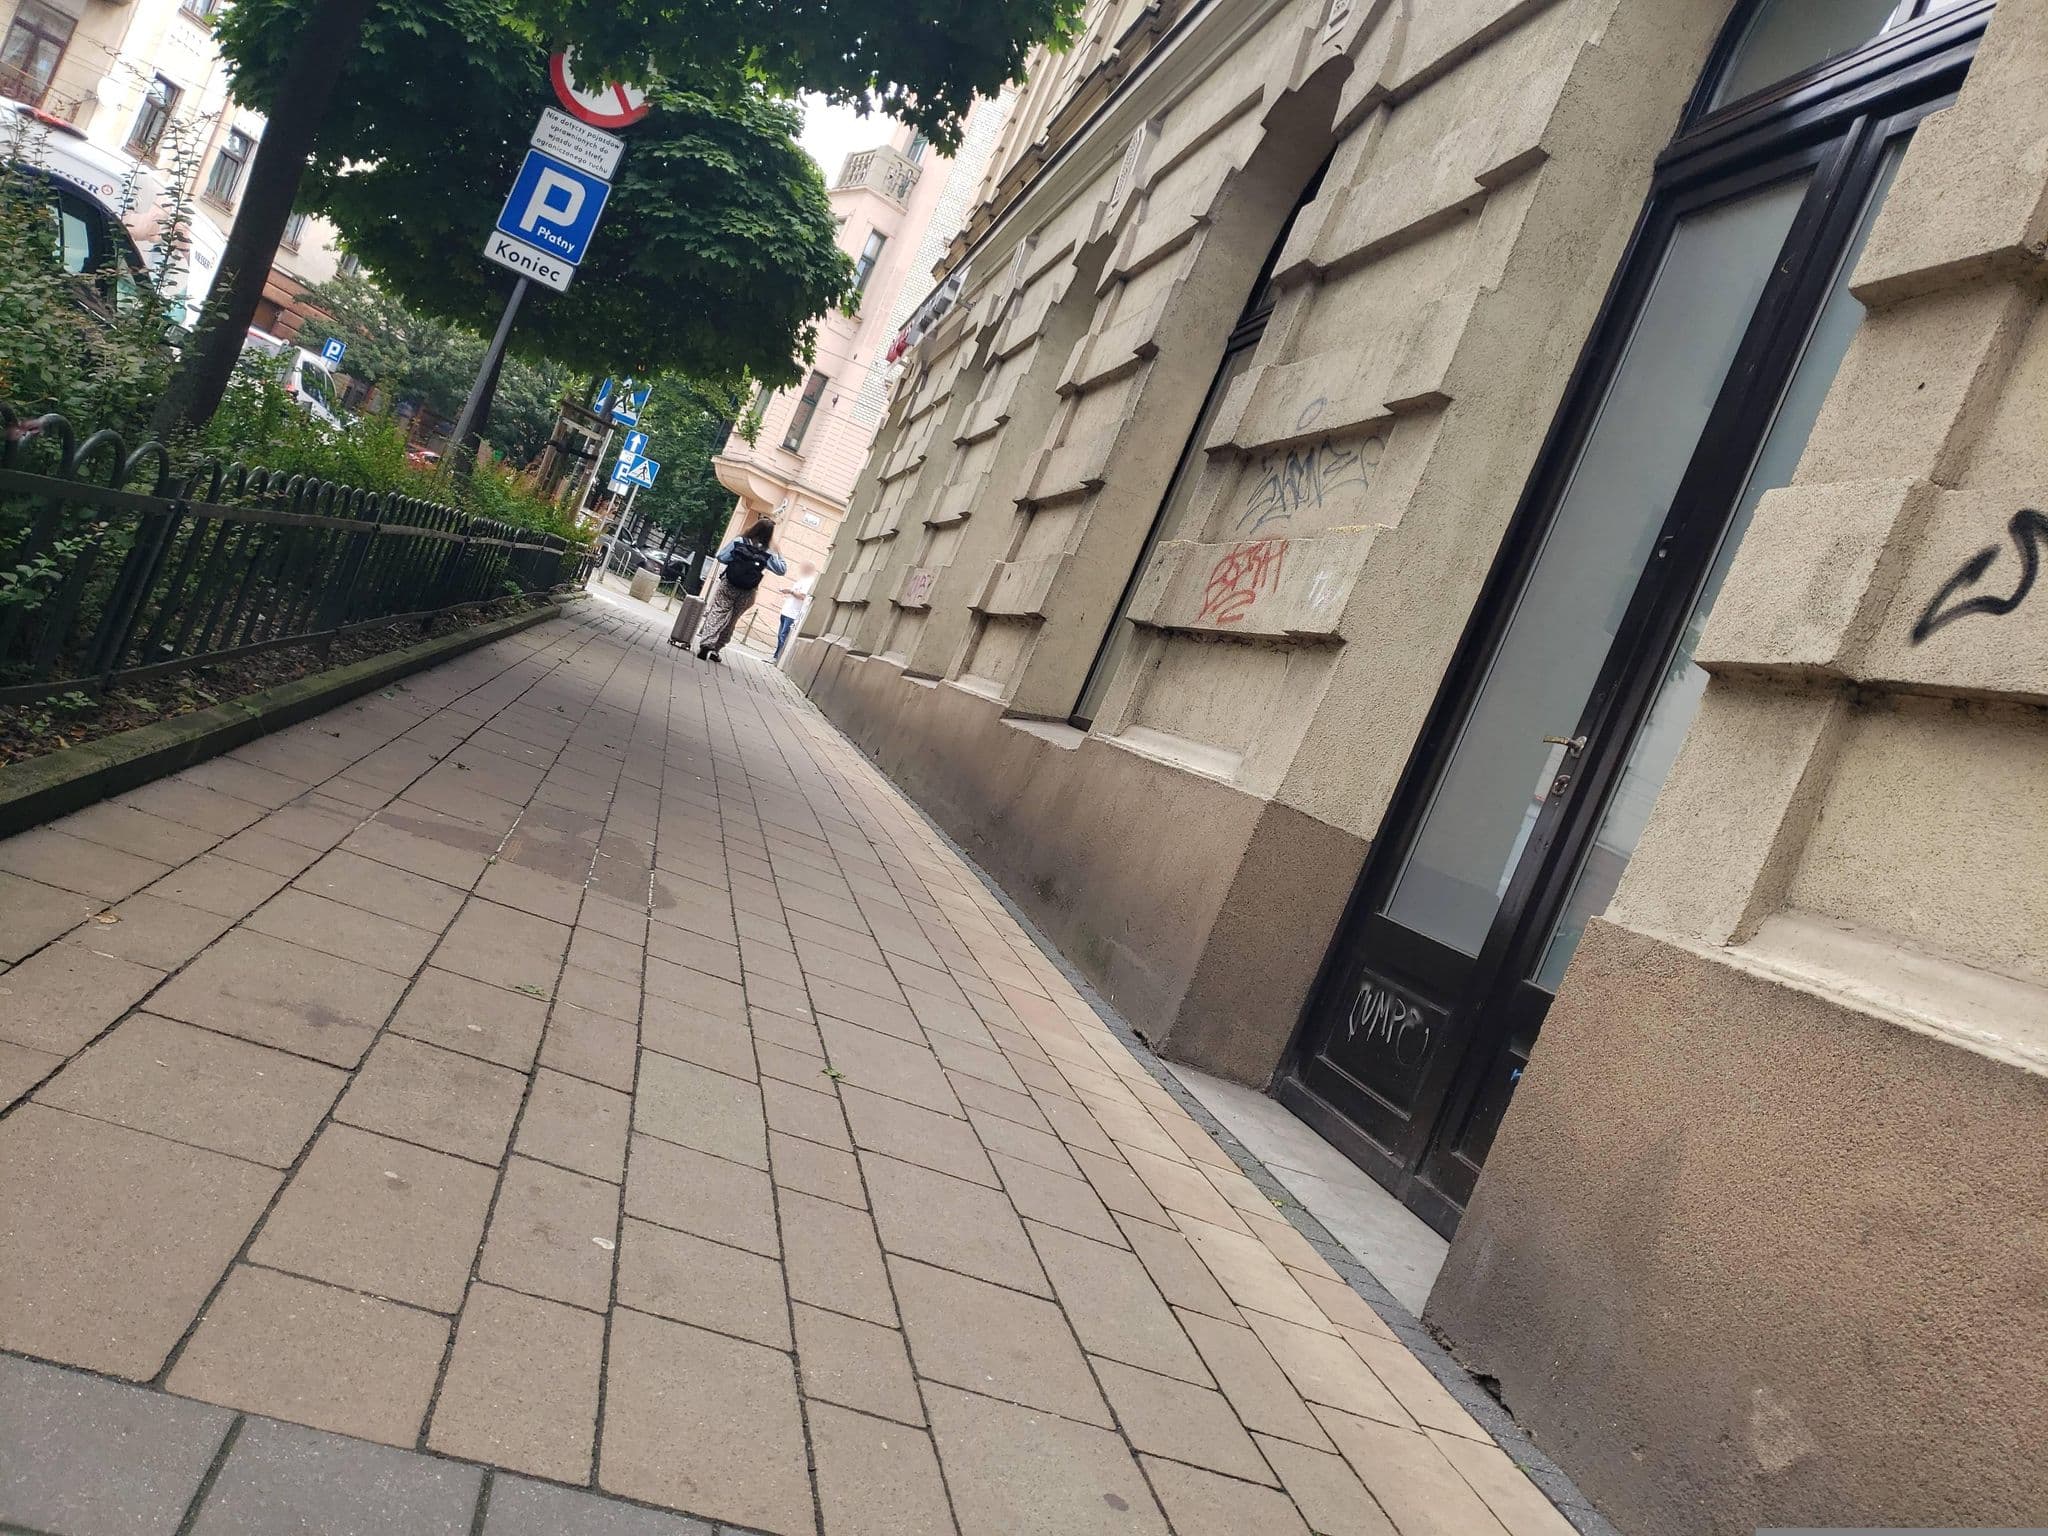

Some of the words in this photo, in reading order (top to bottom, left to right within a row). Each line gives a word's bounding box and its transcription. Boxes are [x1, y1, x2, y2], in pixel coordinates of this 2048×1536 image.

[546, 111, 559, 121] Nie
[560, 118, 587, 134] dotyczy
[548, 133, 573, 148] wjazdu
[573, 144, 583, 153] do
[585, 150, 604, 163] strefy
[550, 124, 598, 149] uprawnionych
[599, 147, 609, 155] do
[536, 137, 587, 164] ograniczonego
[588, 161, 608, 174] ruchu
[519, 167, 586, 232] P
[537, 225, 576, 254] Płatny
[495, 239, 561, 282] Koniec
[326, 341, 342, 358] P
